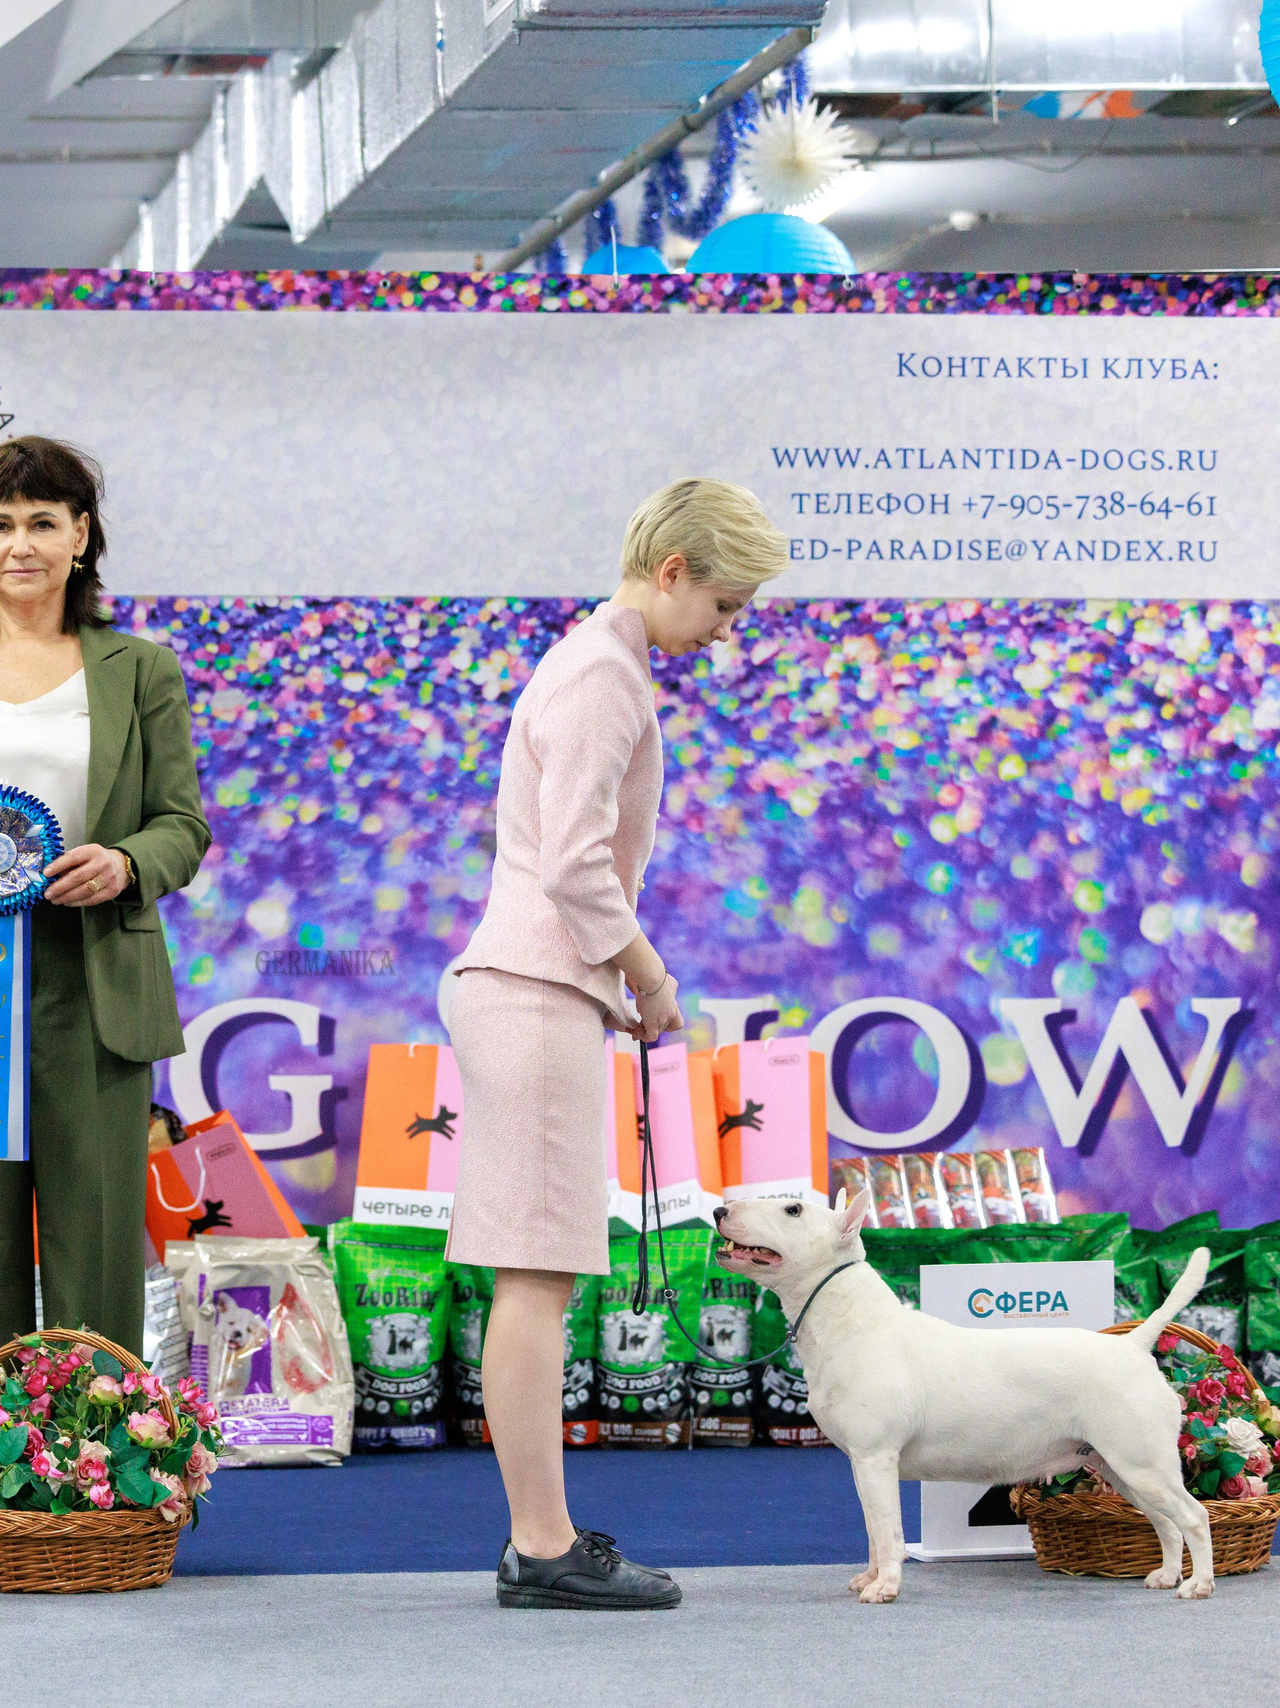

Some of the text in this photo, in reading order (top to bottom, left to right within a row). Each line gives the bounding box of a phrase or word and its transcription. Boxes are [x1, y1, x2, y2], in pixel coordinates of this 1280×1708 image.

[771, 447, 1219, 472] WWW.ATLANTIDA-DOGS.RU
[791, 490, 1218, 521] ТЕЛЕФОН +7-905-738-64-61
[789, 538, 1219, 563] ED-PARADISE@YANDEX.RU
[362, 1201, 433, 1218] четыре
[967, 1288, 1070, 1319] СФЕРА
[371, 1376, 429, 1394] DOG FOOD
[628, 1374, 662, 1389] FOOD
[791, 1380, 809, 1393] DO
